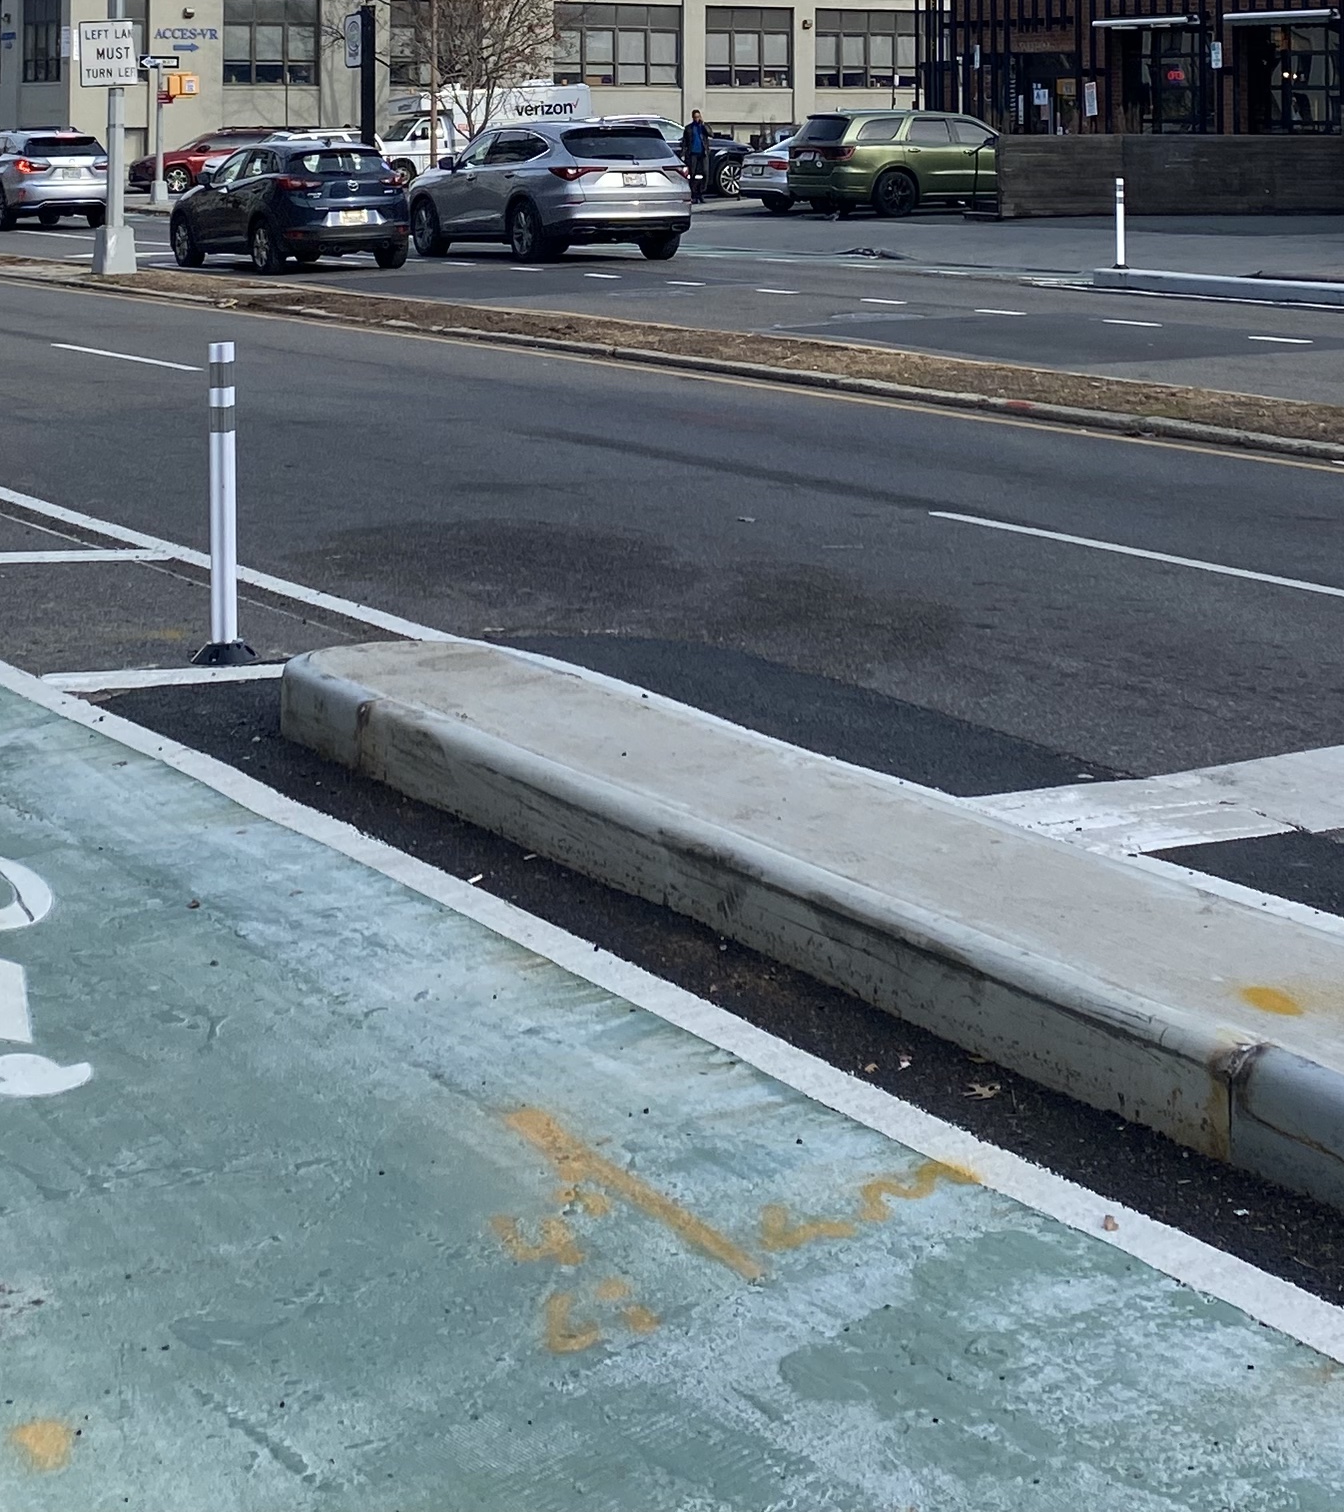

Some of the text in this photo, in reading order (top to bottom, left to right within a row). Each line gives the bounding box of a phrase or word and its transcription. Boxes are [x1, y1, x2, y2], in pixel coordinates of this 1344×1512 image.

[84, 29, 132, 41] LEFT LAN
[154, 28, 219, 40] ACCES-VR
[96, 47, 131, 61] MUST
[85, 67, 136, 79] TURN LEF
[516, 100, 573, 117] verizon
